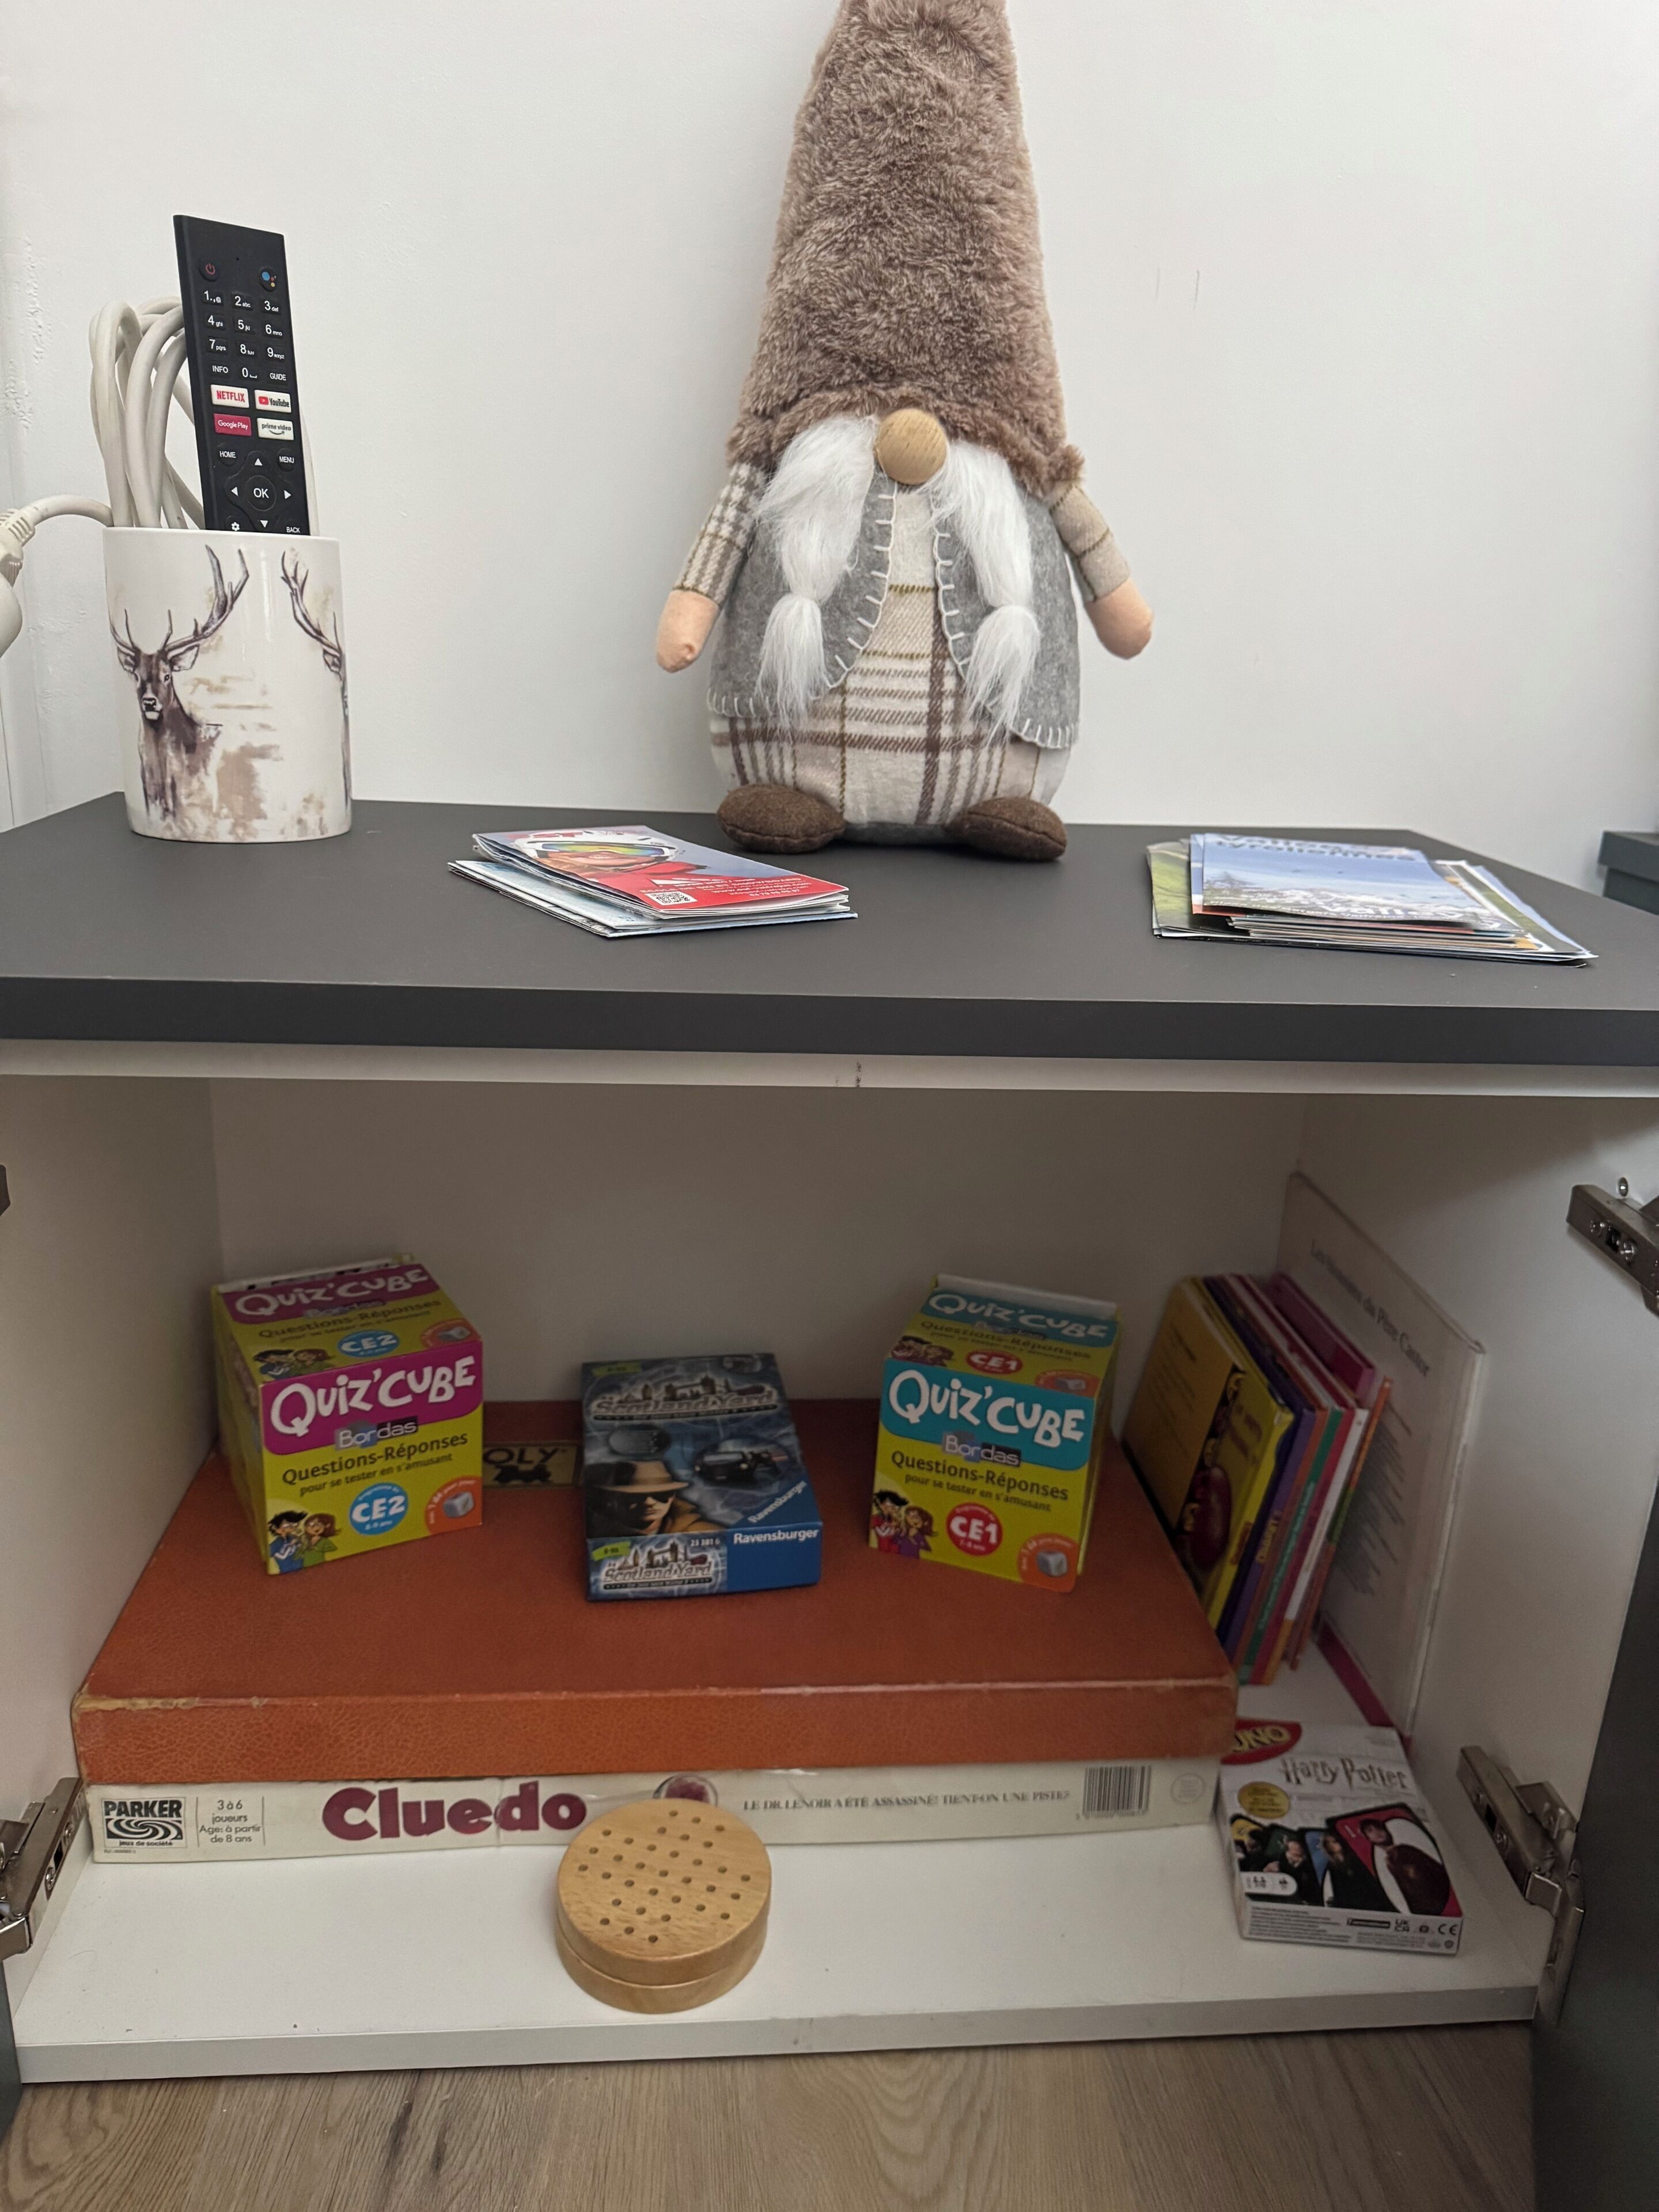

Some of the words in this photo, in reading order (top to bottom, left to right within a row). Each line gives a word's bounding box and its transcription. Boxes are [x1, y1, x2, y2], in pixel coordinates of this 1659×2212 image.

[270, 373, 286, 381] GUIDE
[217, 390, 245, 403] NETFLIX
[269, 397, 289, 408] YouTube
[218, 419, 237, 429] Google
[237, 422, 248, 430] Play
[262, 423, 276, 431] prime
[219, 450, 236, 459] HOME
[253, 487, 269, 498] OK
[340, 1334, 398, 1353] CE2
[969, 1354, 1018, 1371] CE1
[338, 1421, 417, 1448] Bordas
[282, 1431, 468, 1485] Questions-Réponses
[944, 1434, 1021, 1466] Bordas
[300, 1481, 326, 1497] pour
[329, 1478, 342, 1488] se
[345, 1469, 378, 1484] tester
[380, 1466, 394, 1477] en
[891, 1450, 1069, 1501] Questions-Réponses
[904, 1472, 930, 1486] pour
[979, 1488, 993, 1498] en
[351, 1495, 406, 1524] CE2
[748, 1480, 807, 1524] Ravensburger
[733, 1528, 820, 1544] Ravensburger
[949, 1516, 998, 1546] CE1
[1281, 1758, 1341, 1785] Harry
[1341, 1758, 1407, 1789] Potter
[104, 1800, 183, 1818] PARKER
[217, 1800, 225, 1810] 3
[227, 1800, 234, 1809] à
[236, 1800, 243, 1809] 6
[322, 1780, 586, 1841] Cluedo
[744, 1800, 759, 1810] LE
[785, 1798, 831, 1809] LENOIR
[211, 1813, 248, 1824] joueurs
[225, 1824, 233, 1833] à
[234, 1824, 261, 1834] partir
[210, 1834, 224, 1843] de
[225, 1834, 233, 1843] 8
[234, 1834, 252, 1843] ans
